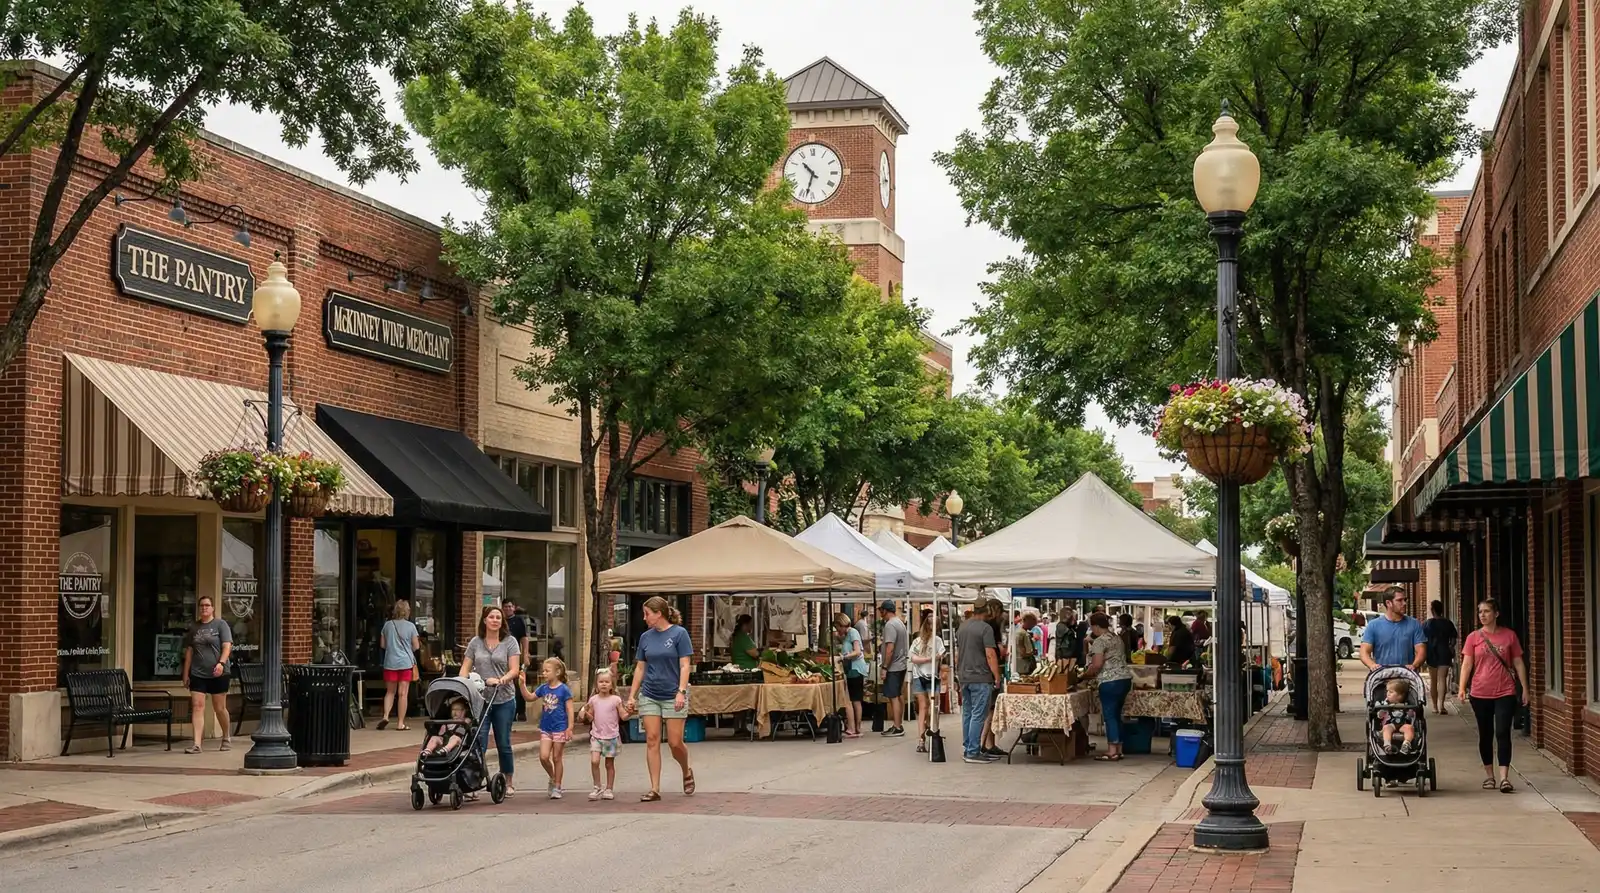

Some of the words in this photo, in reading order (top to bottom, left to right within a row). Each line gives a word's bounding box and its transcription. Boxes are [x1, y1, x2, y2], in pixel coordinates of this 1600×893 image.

[127, 244, 170, 284] THE
[174, 258, 248, 305] PANTRY
[381, 318, 405, 349] WINE
[406, 326, 450, 361] MERCHANT
[59, 577, 73, 590] THE
[74, 577, 101, 591] PANTRY
[225, 581, 236, 593] THE
[236, 581, 258, 593] PANTRY
